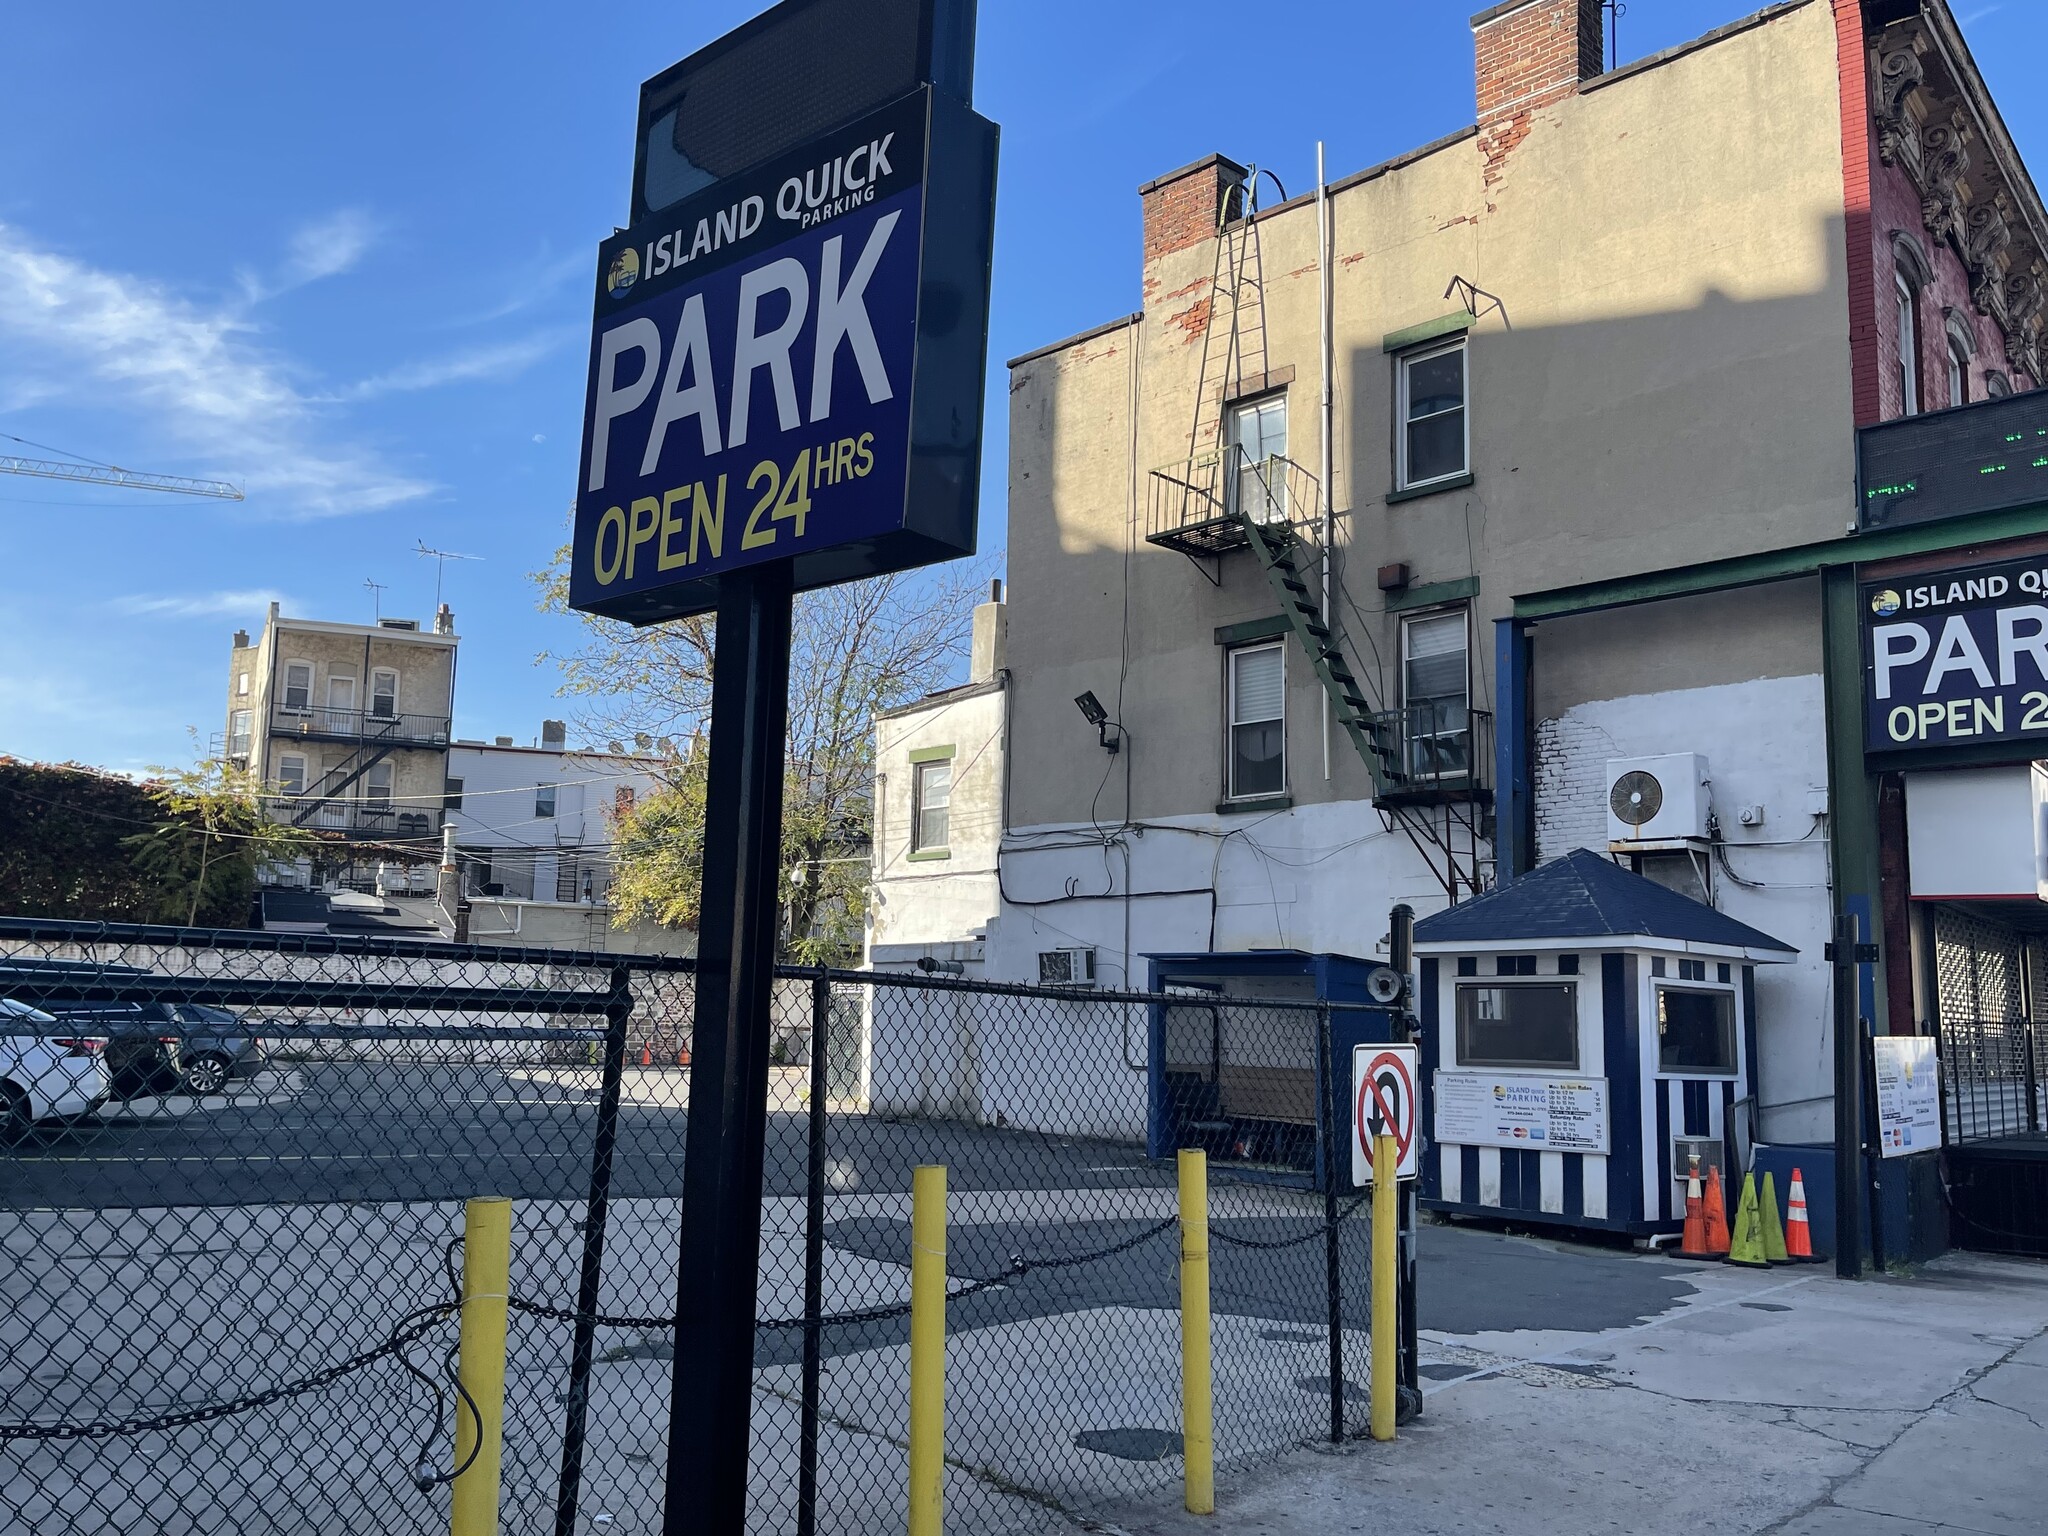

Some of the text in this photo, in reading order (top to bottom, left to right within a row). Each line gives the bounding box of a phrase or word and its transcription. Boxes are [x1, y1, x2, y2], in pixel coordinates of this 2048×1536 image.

[645, 132, 895, 281] ISLAND QUICK
[801, 184, 875, 230] PARKING
[588, 209, 903, 493] PARK
[594, 432, 875, 586] OPEN 24 HRS
[1905, 575, 2009, 610] ISLAND
[1873, 604, 2048, 700] PAR
[1888, 691, 2048, 742] OPEN 2
[1507, 1086, 1530, 1094] ISLAND
[1507, 1094, 1546, 1103] PARKING
